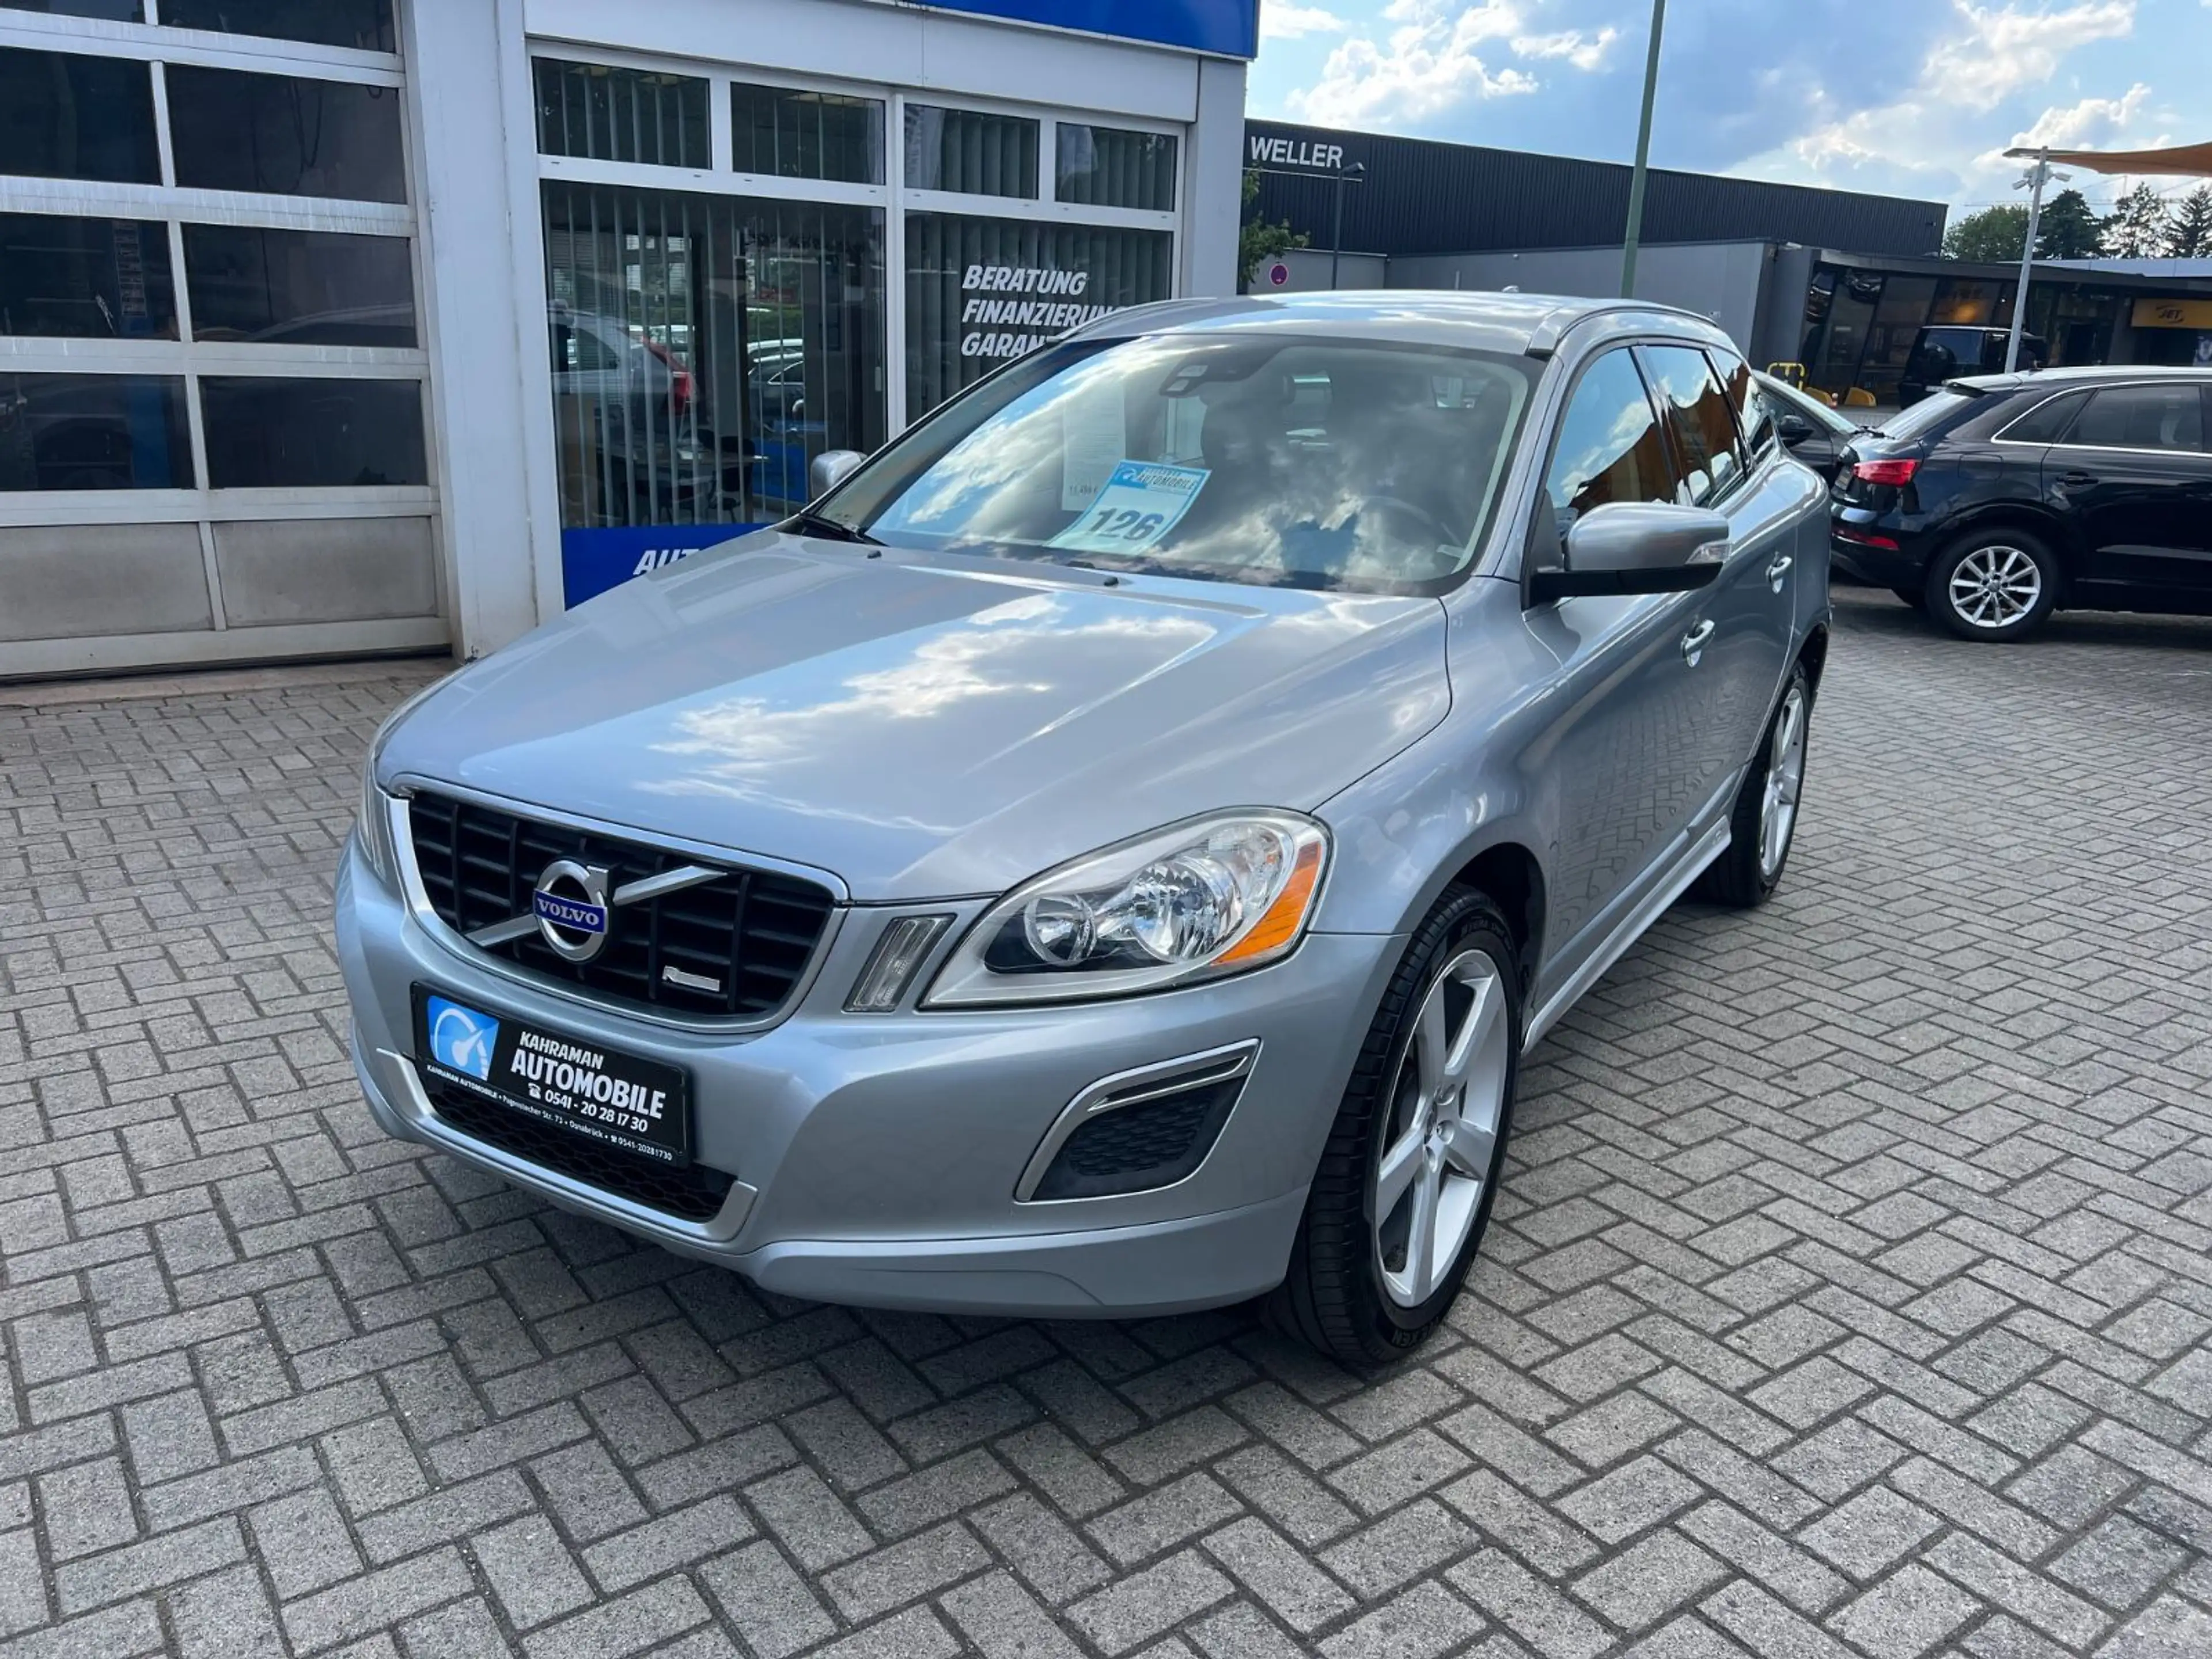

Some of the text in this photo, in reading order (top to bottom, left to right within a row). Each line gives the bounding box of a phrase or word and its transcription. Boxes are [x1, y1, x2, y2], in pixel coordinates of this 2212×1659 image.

[1251, 136, 1343, 169] WELLER
[962, 265, 1088, 296] BERATUNG
[962, 298, 1129, 328] FINANZIERU
[961, 332, 1059, 357] GARAN
[1088, 507, 1165, 540] 126
[632, 548, 700, 575] AU
[537, 897, 600, 926] VOLVO
[520, 1031, 604, 1070] KAHRAMAN
[510, 1048, 666, 1119] AUTOMOBILE
[459, 1078, 499, 1099] AUTOMOBILE
[569, 1120, 604, 1139] Osnabrück
[544, 1089, 572, 1109] 0541
[580, 1101, 597, 1117] 20
[599, 1107, 615, 1123] 28
[618, 1112, 630, 1127] 17
[630, 1116, 648, 1132] 30
